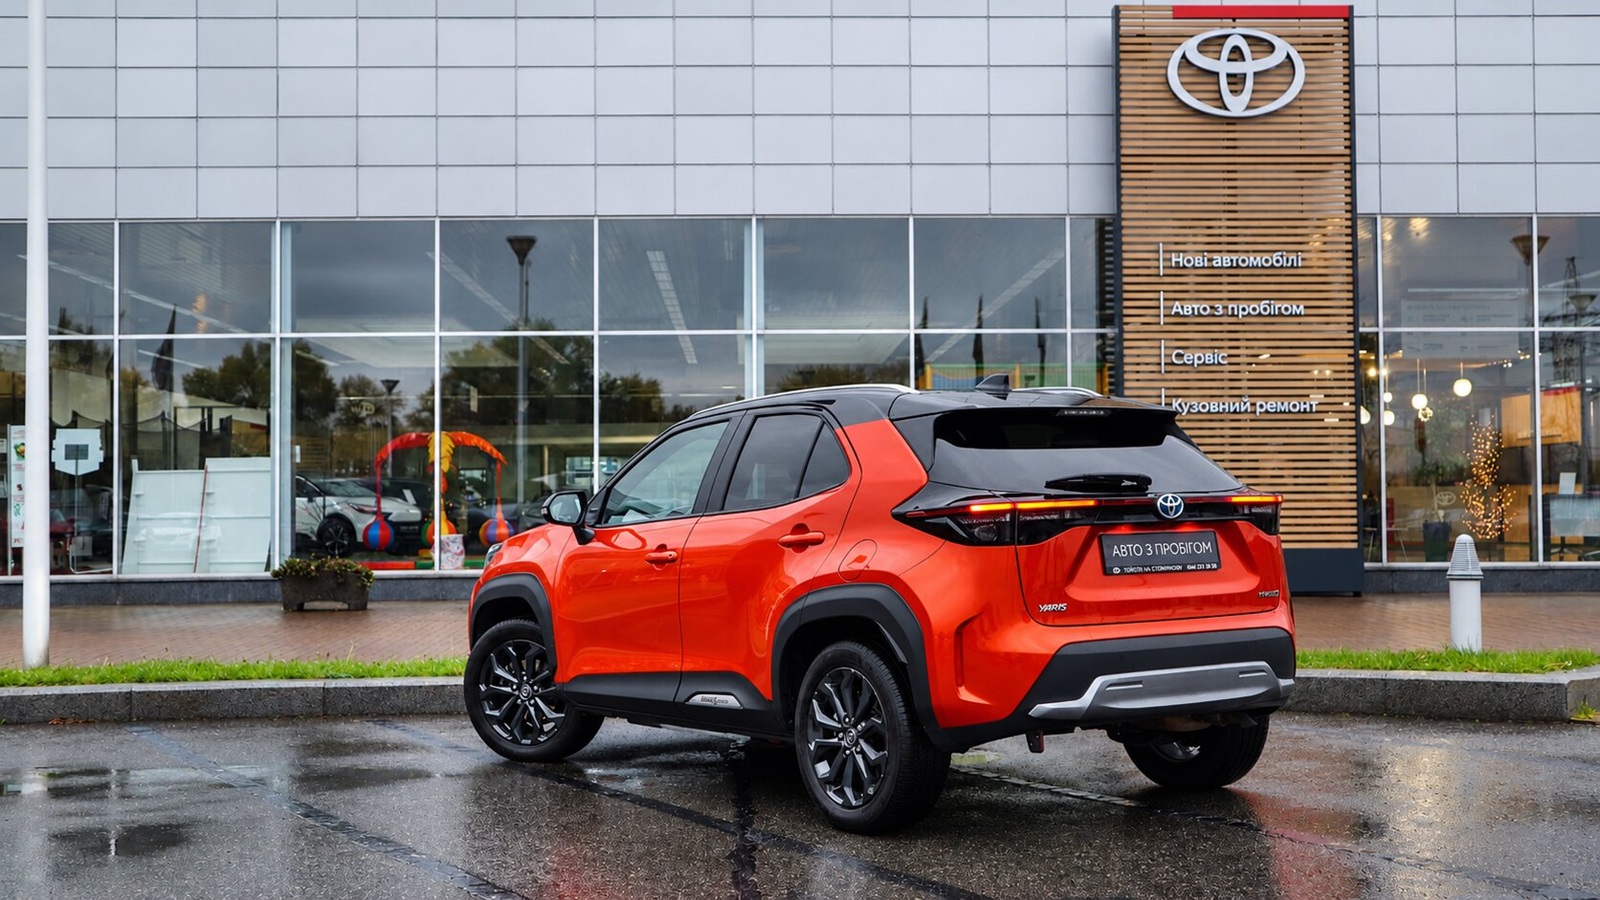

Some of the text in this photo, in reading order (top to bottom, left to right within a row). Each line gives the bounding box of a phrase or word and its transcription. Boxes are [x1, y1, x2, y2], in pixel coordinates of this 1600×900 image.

[1171, 252, 1302, 267] Нові автомобілі
[1171, 301, 1305, 319] Авто з пробігом
[1171, 349, 1228, 368] Сервіс
[1171, 395, 1319, 416] Кузовний ремонт
[1112, 541, 1213, 557] АВТО З ПРОБІГОМ
[1038, 603, 1067, 612] YARIS
